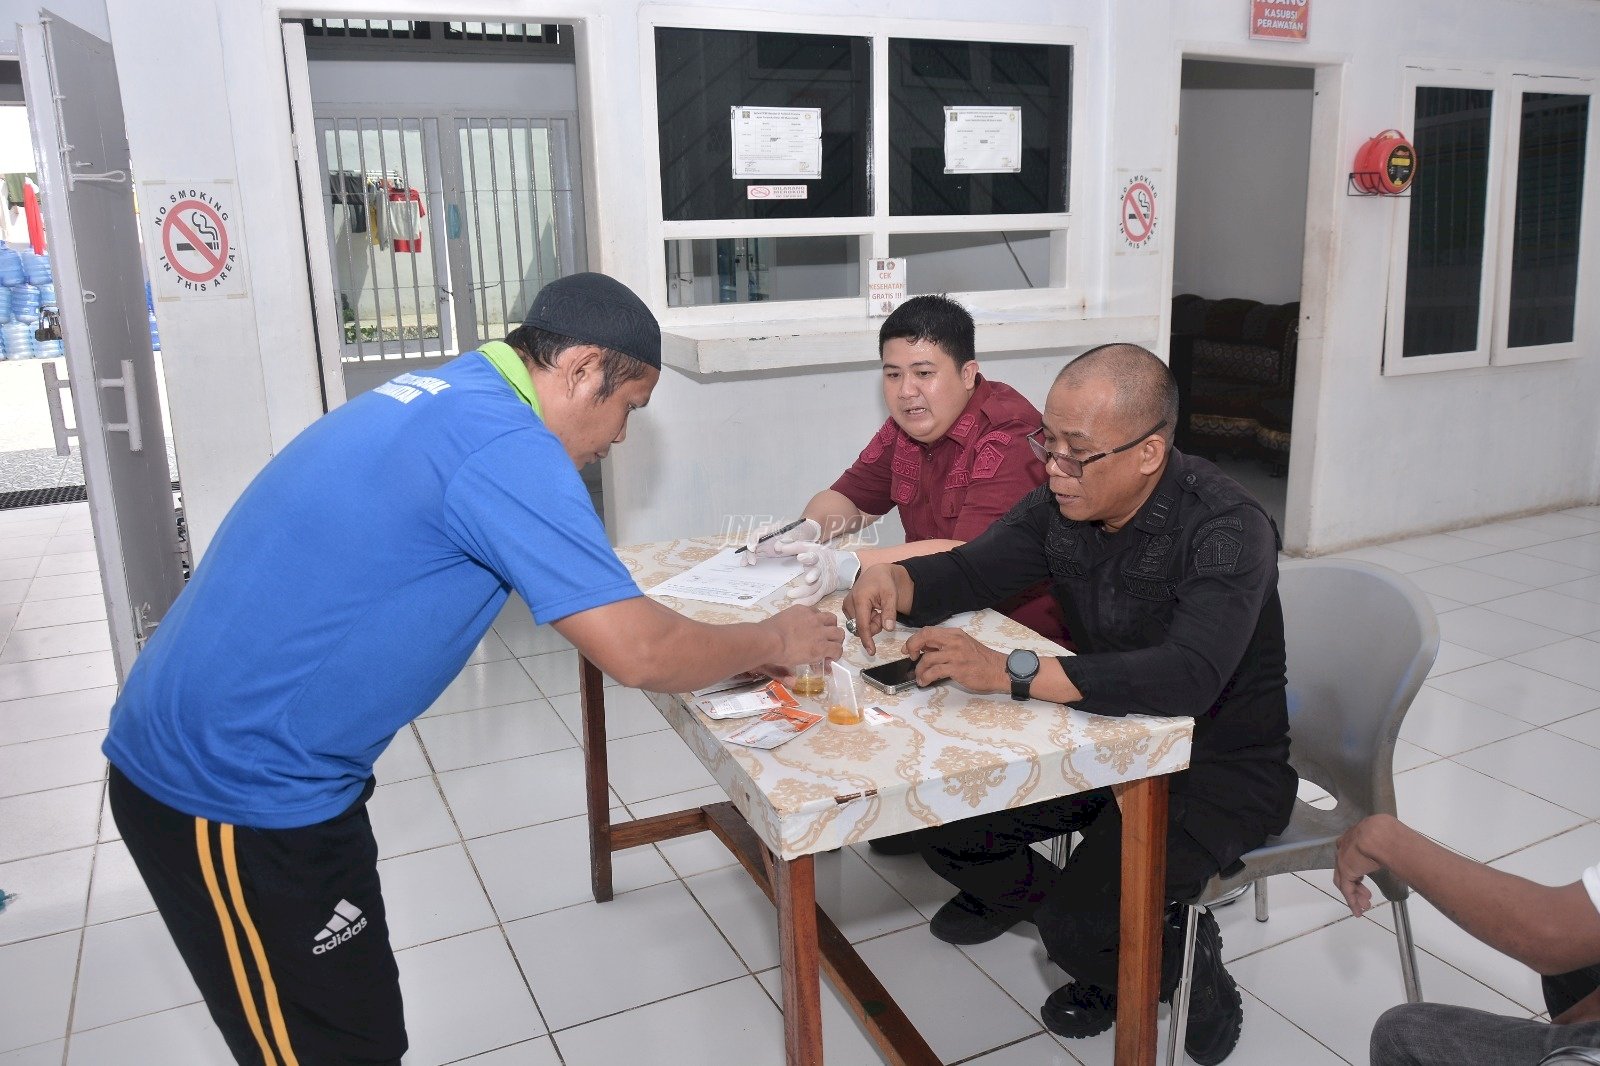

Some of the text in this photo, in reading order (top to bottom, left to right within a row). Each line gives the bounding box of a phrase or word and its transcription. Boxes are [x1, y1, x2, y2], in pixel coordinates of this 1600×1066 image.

[1264, 8, 1298, 19] KASUBSI
[1257, 18, 1304, 31] PERAWATAN
[1120, 174, 1158, 200] NO SMOKING
[155, 189, 229, 226] NO SMOKING
[160, 246, 236, 292] IN THIS AREA!
[879, 272, 892, 280] CEK
[871, 292, 894, 300] GRATIS
[312, 917, 368, 955] adidas
